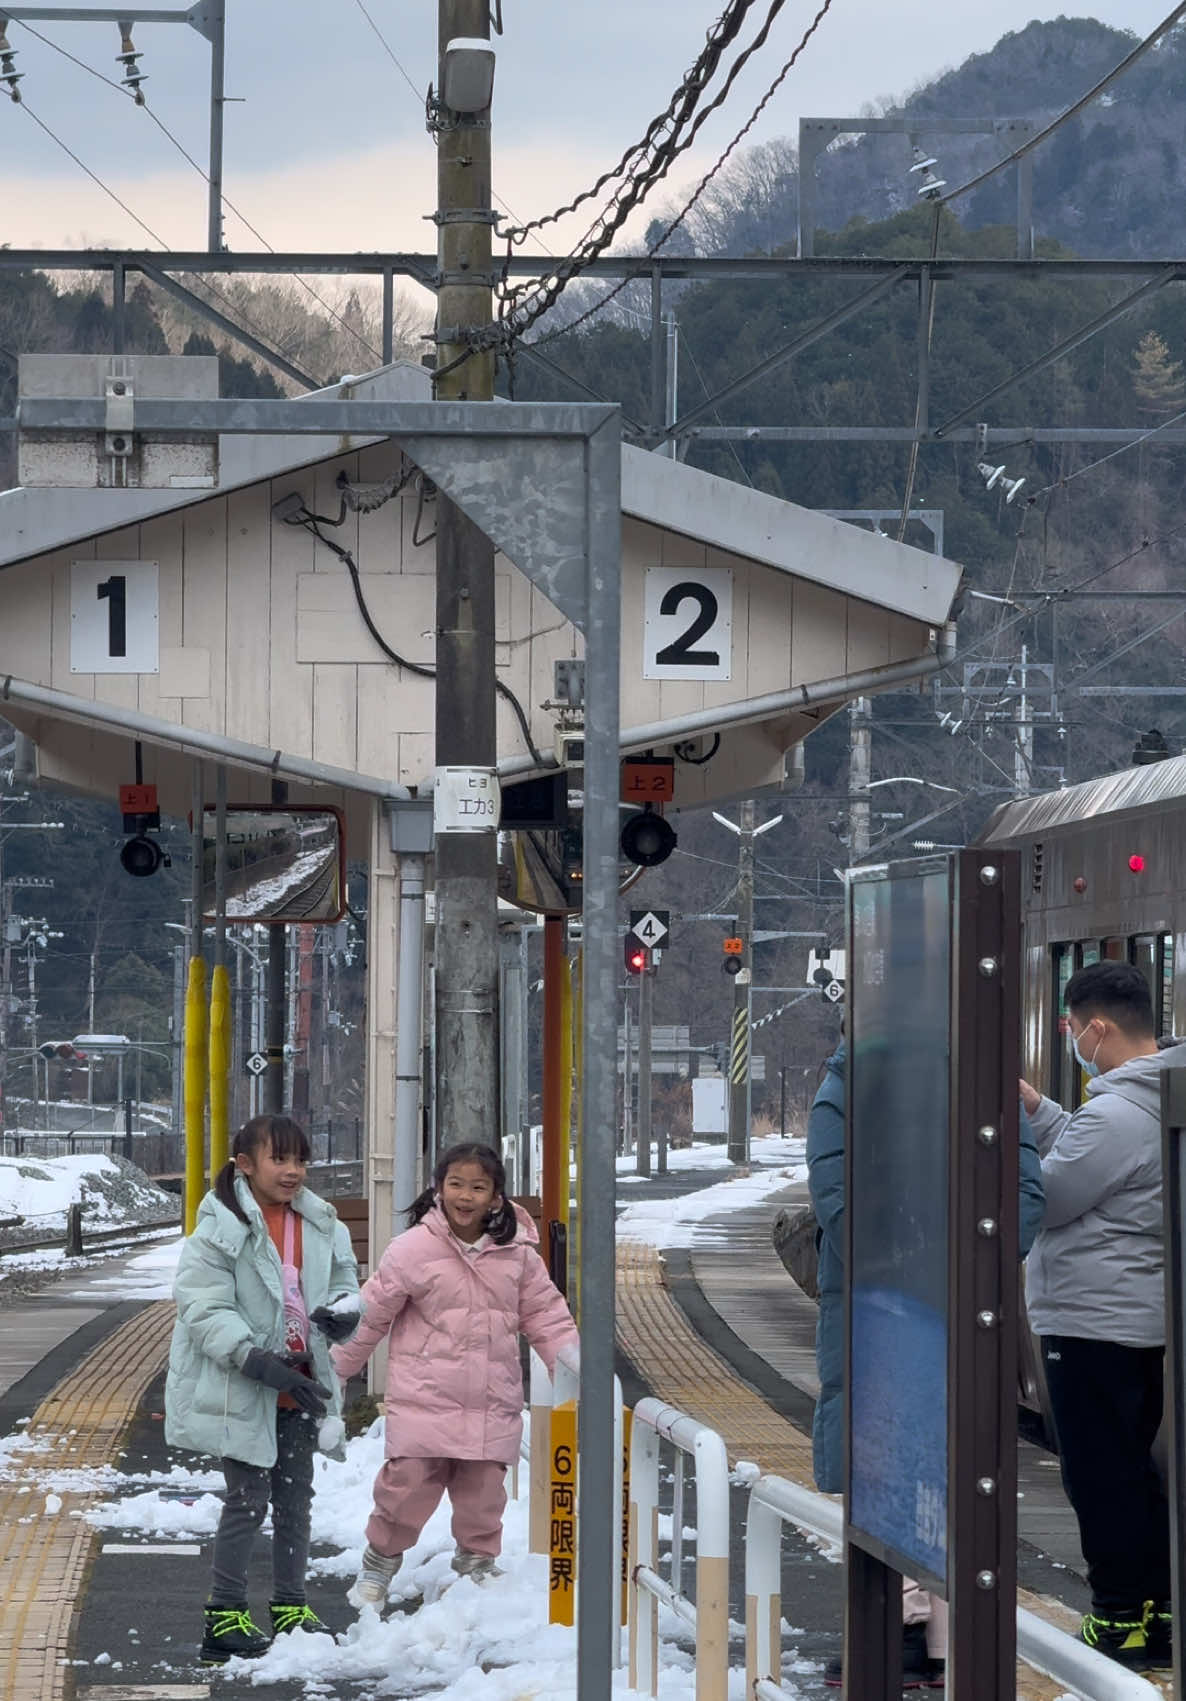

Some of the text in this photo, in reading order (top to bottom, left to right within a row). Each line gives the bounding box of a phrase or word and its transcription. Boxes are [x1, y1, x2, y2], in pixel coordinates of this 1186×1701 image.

[97, 576, 127, 657] 1
[656, 582, 720, 666] 2
[642, 919, 656, 939] 4
[829, 984, 839, 997] 6
[252, 1057, 262, 1070] 6
[550, 1445, 574, 1592] 6両限界
